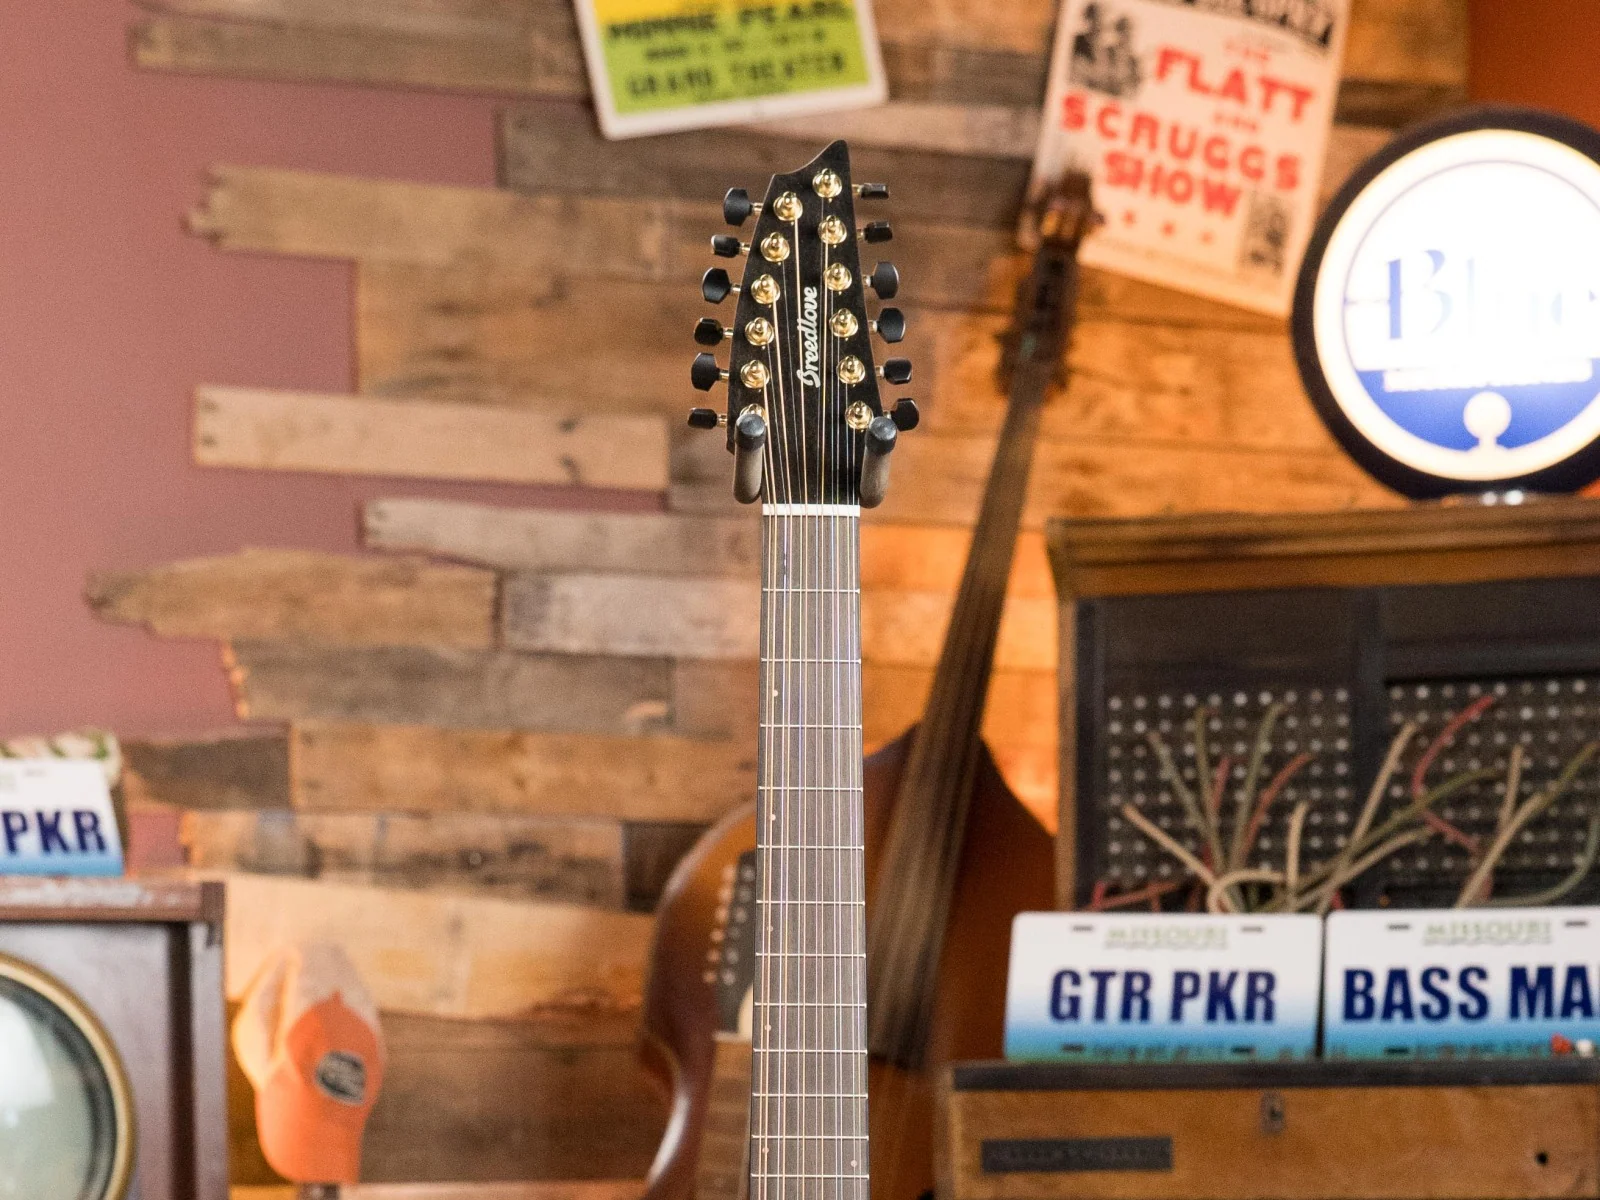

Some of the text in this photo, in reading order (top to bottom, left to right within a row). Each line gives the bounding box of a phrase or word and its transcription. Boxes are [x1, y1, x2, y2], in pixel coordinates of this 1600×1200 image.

[1156, 43, 1314, 123] FLATT
[1062, 91, 1300, 191] SCRUGGS
[1104, 151, 1242, 218] SHOW
[797, 286, 821, 388] Breedlove
[2, 810, 107, 855] PKR
[1049, 969, 1277, 1024] GTR PKR
[1343, 964, 1600, 1021] BASS MA
